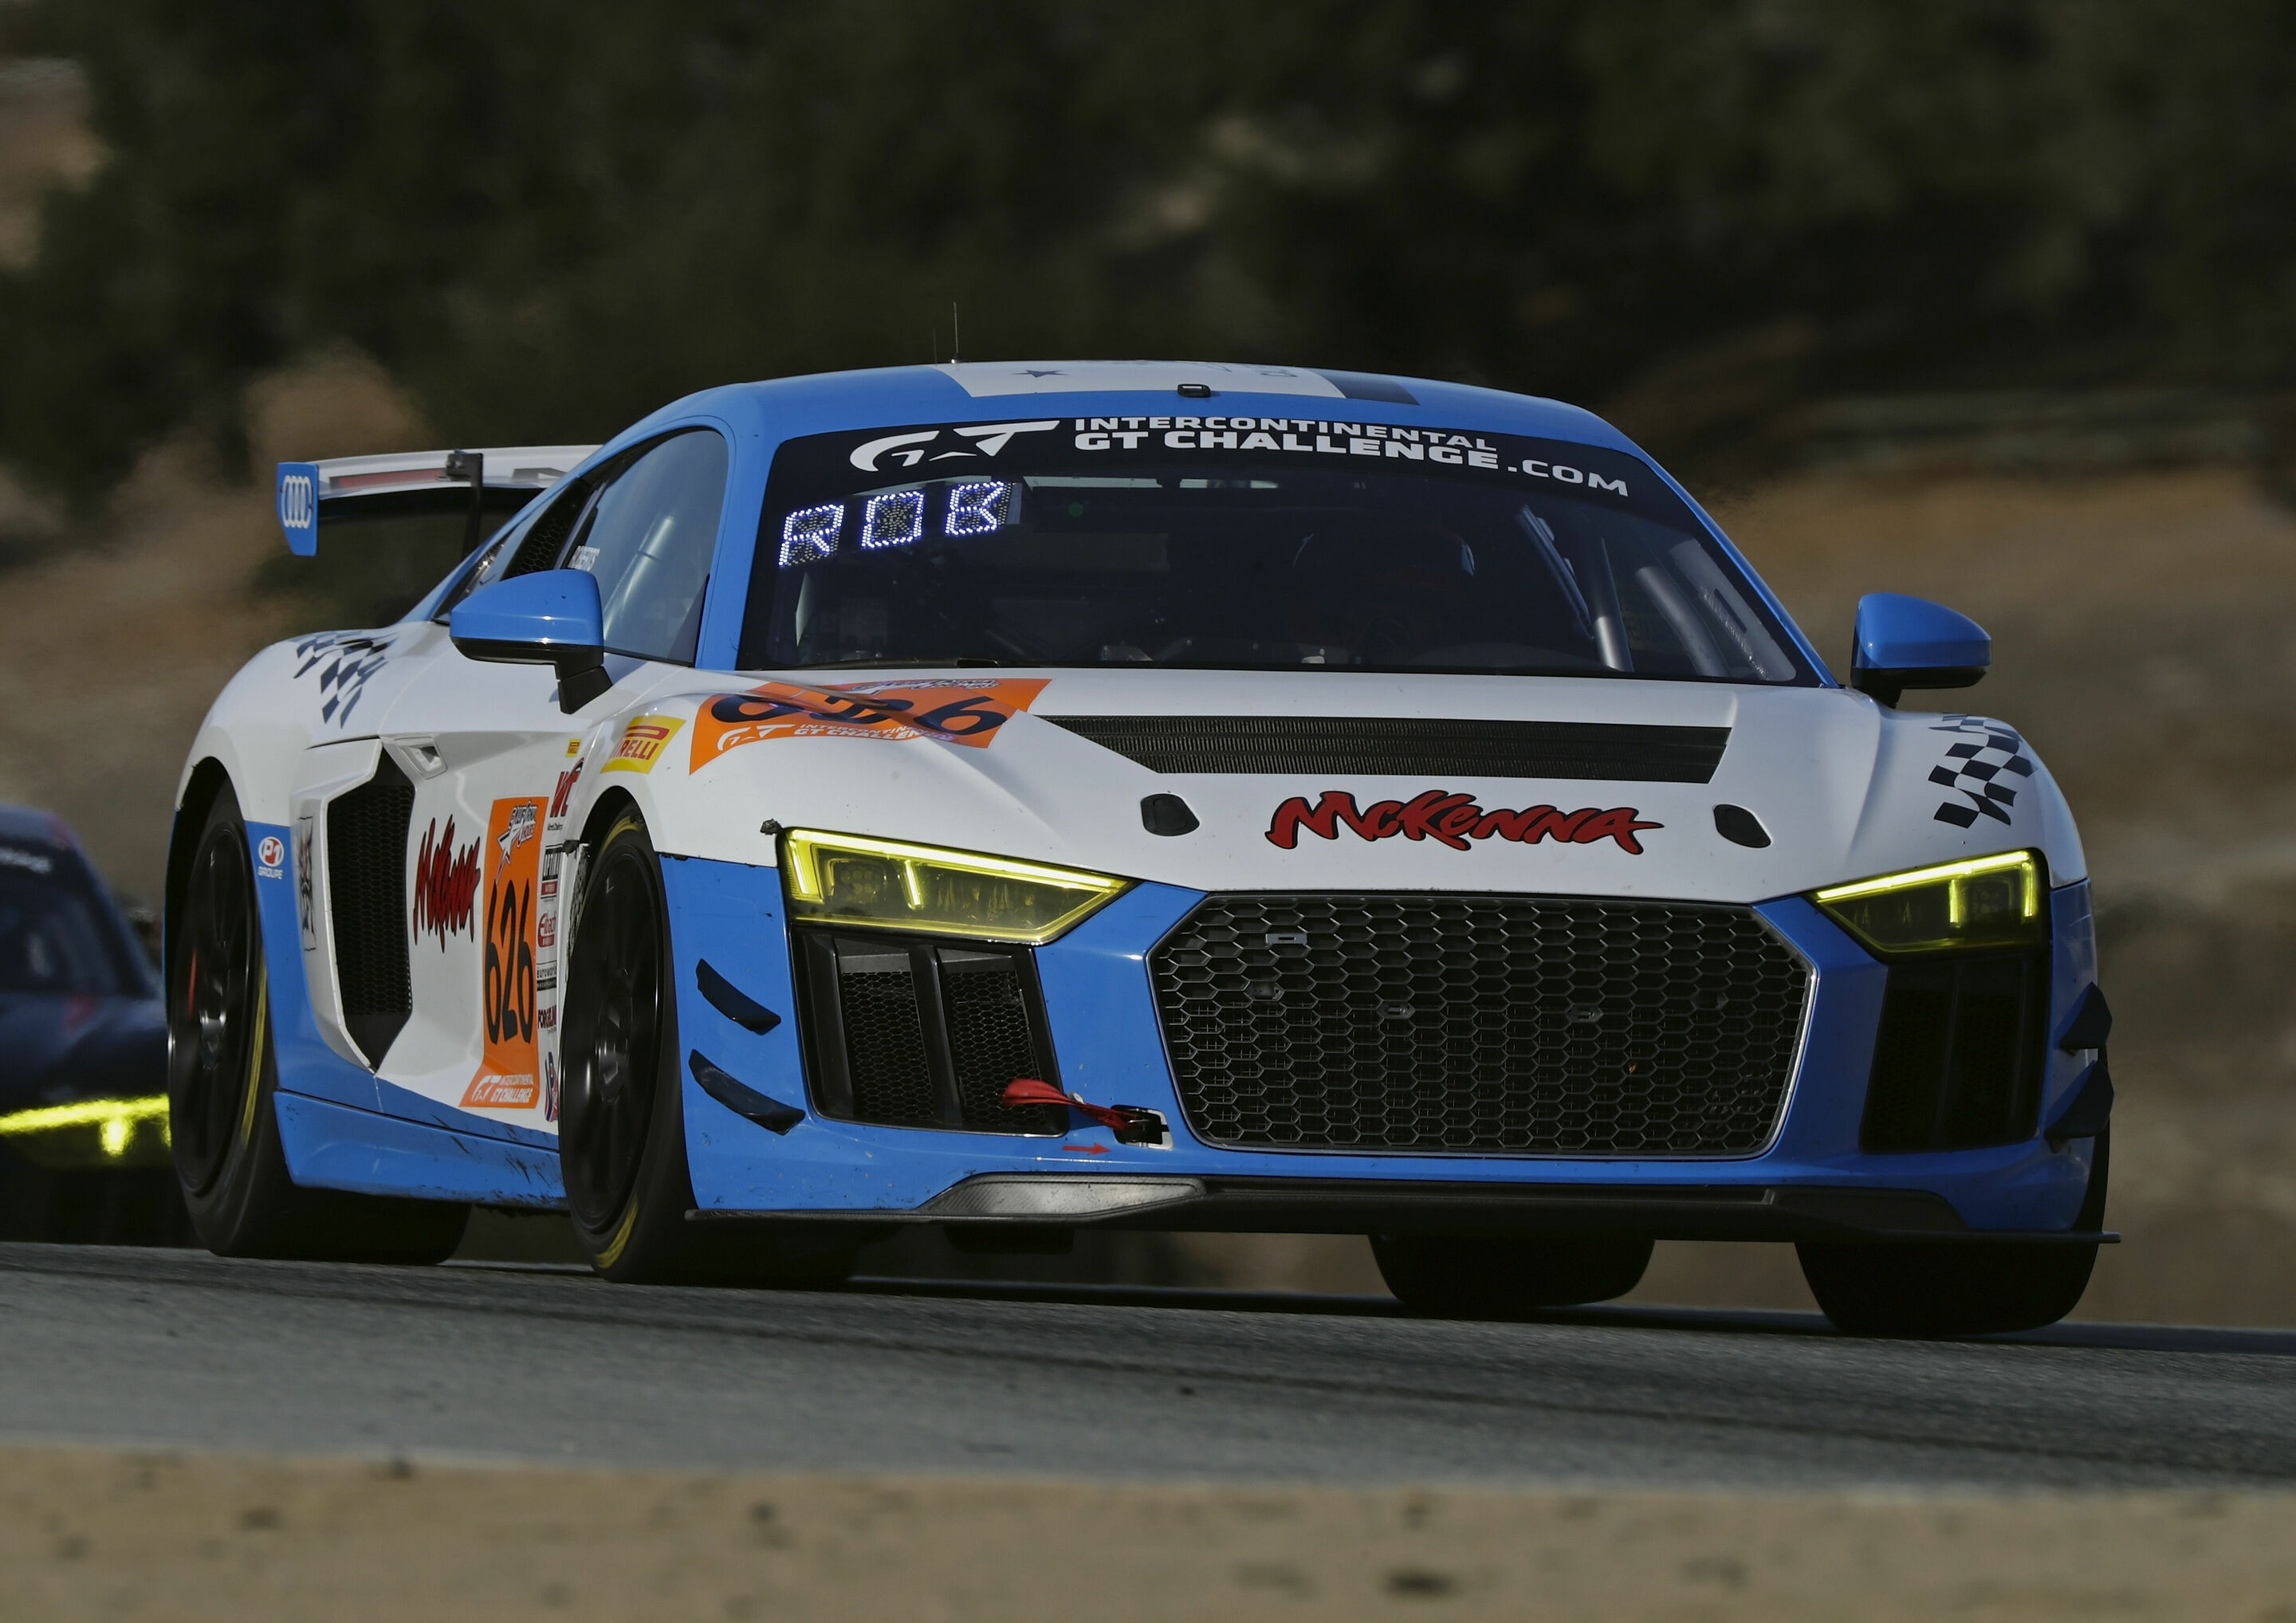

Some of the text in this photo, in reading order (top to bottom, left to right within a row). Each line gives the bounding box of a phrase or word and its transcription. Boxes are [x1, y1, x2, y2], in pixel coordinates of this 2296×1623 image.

[1075, 417, 1496, 451] INTERCONTINENTAL
[1075, 431, 1149, 450] GT
[263, 839, 282, 866] P1
[258, 866, 283, 880] GROUPE
[485, 878, 534, 1045] 626
